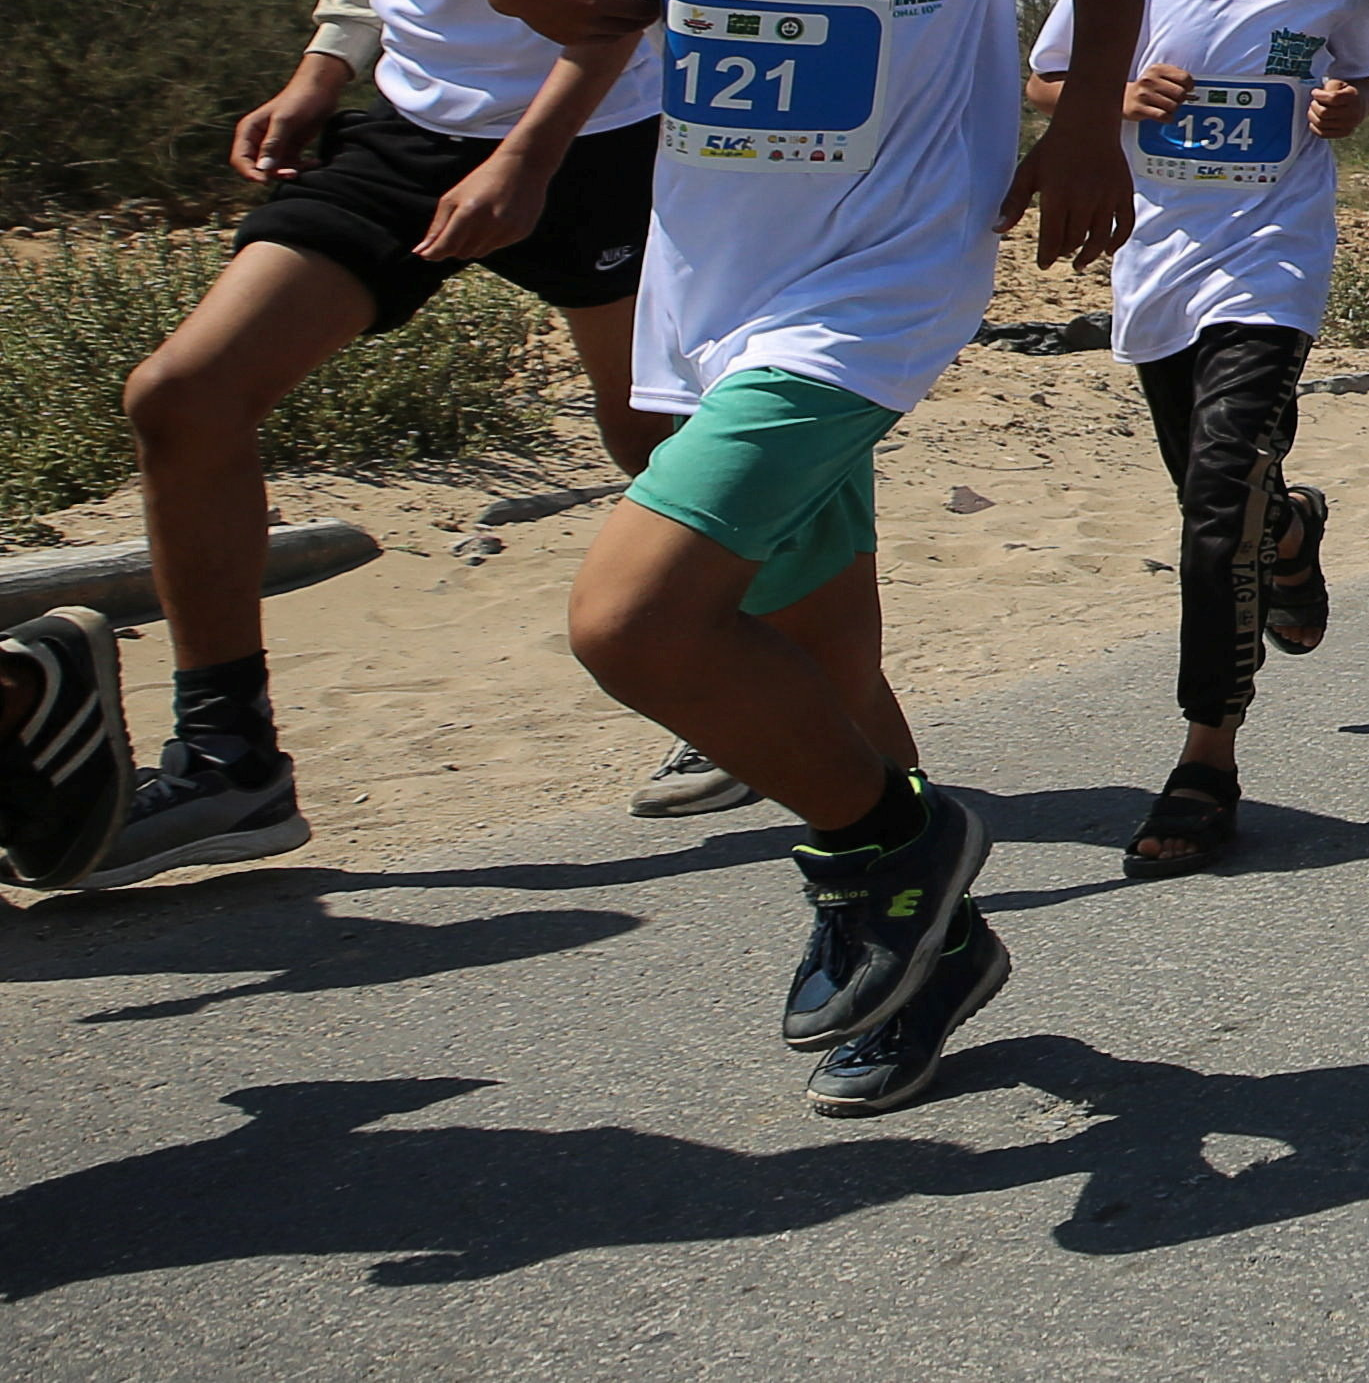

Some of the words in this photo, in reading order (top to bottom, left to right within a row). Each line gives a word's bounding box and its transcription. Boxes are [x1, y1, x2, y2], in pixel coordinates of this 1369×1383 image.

[675, 52, 795, 112] 121
[1177, 115, 1253, 151] 134
[602, 245, 632, 262] NIKE
[1231, 560, 1257, 604] TAG
